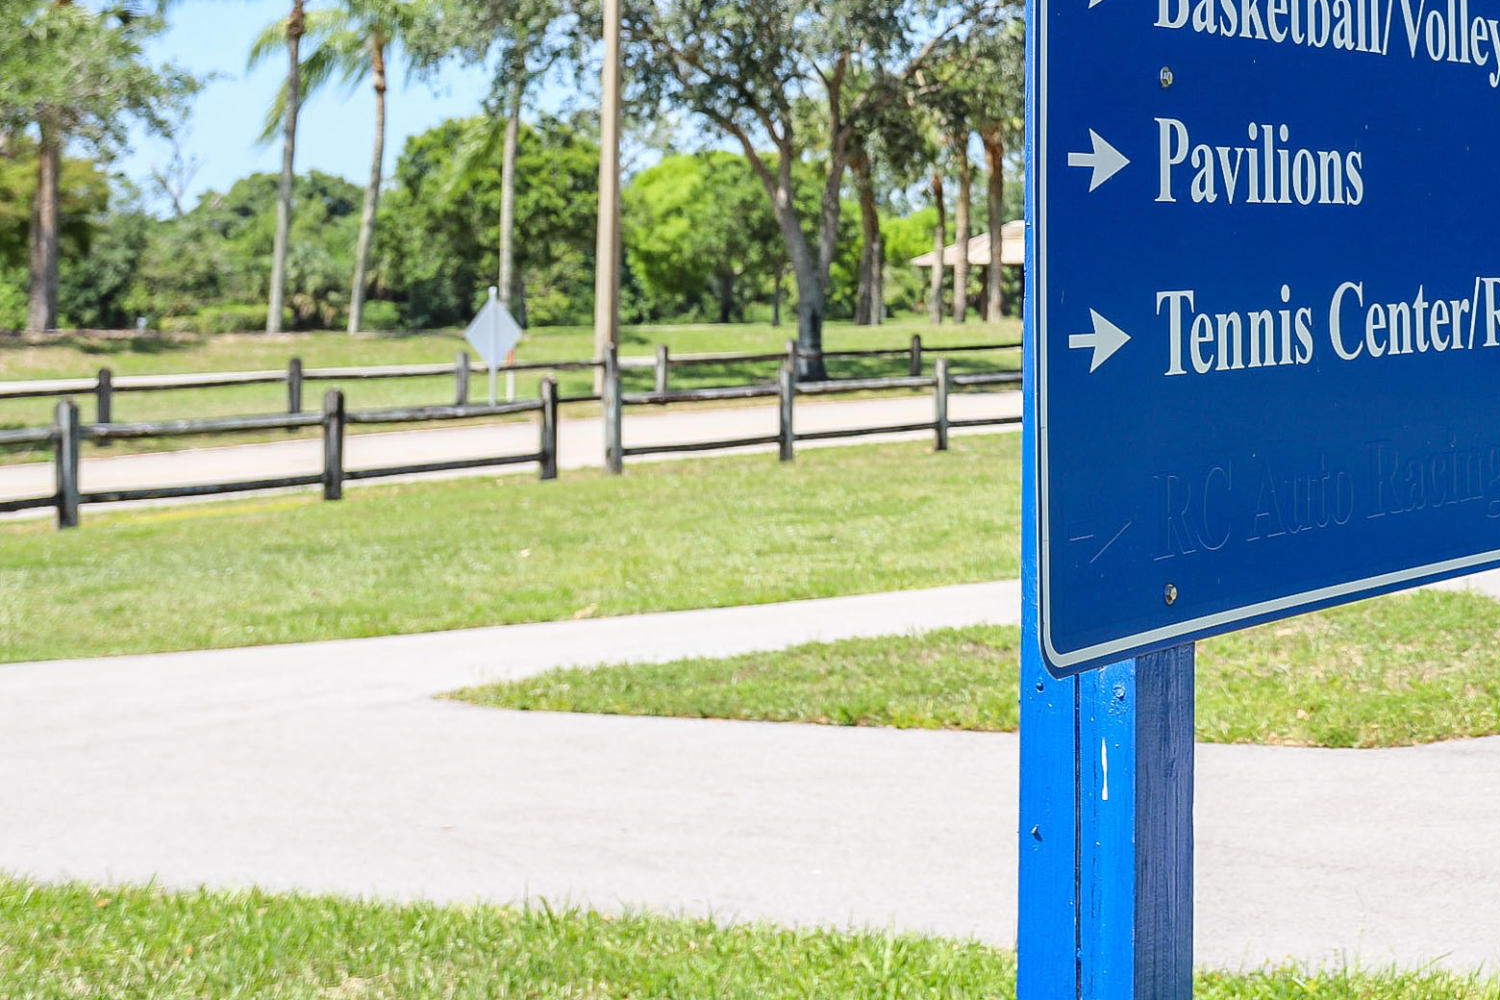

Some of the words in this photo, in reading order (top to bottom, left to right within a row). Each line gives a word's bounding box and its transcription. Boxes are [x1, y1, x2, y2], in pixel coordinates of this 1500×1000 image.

[1155, 118, 1363, 205] Pavilions
[1157, 285, 1313, 375] Tennis
[1153, 460, 1232, 561] RC
[1246, 449, 1354, 541] Auto
